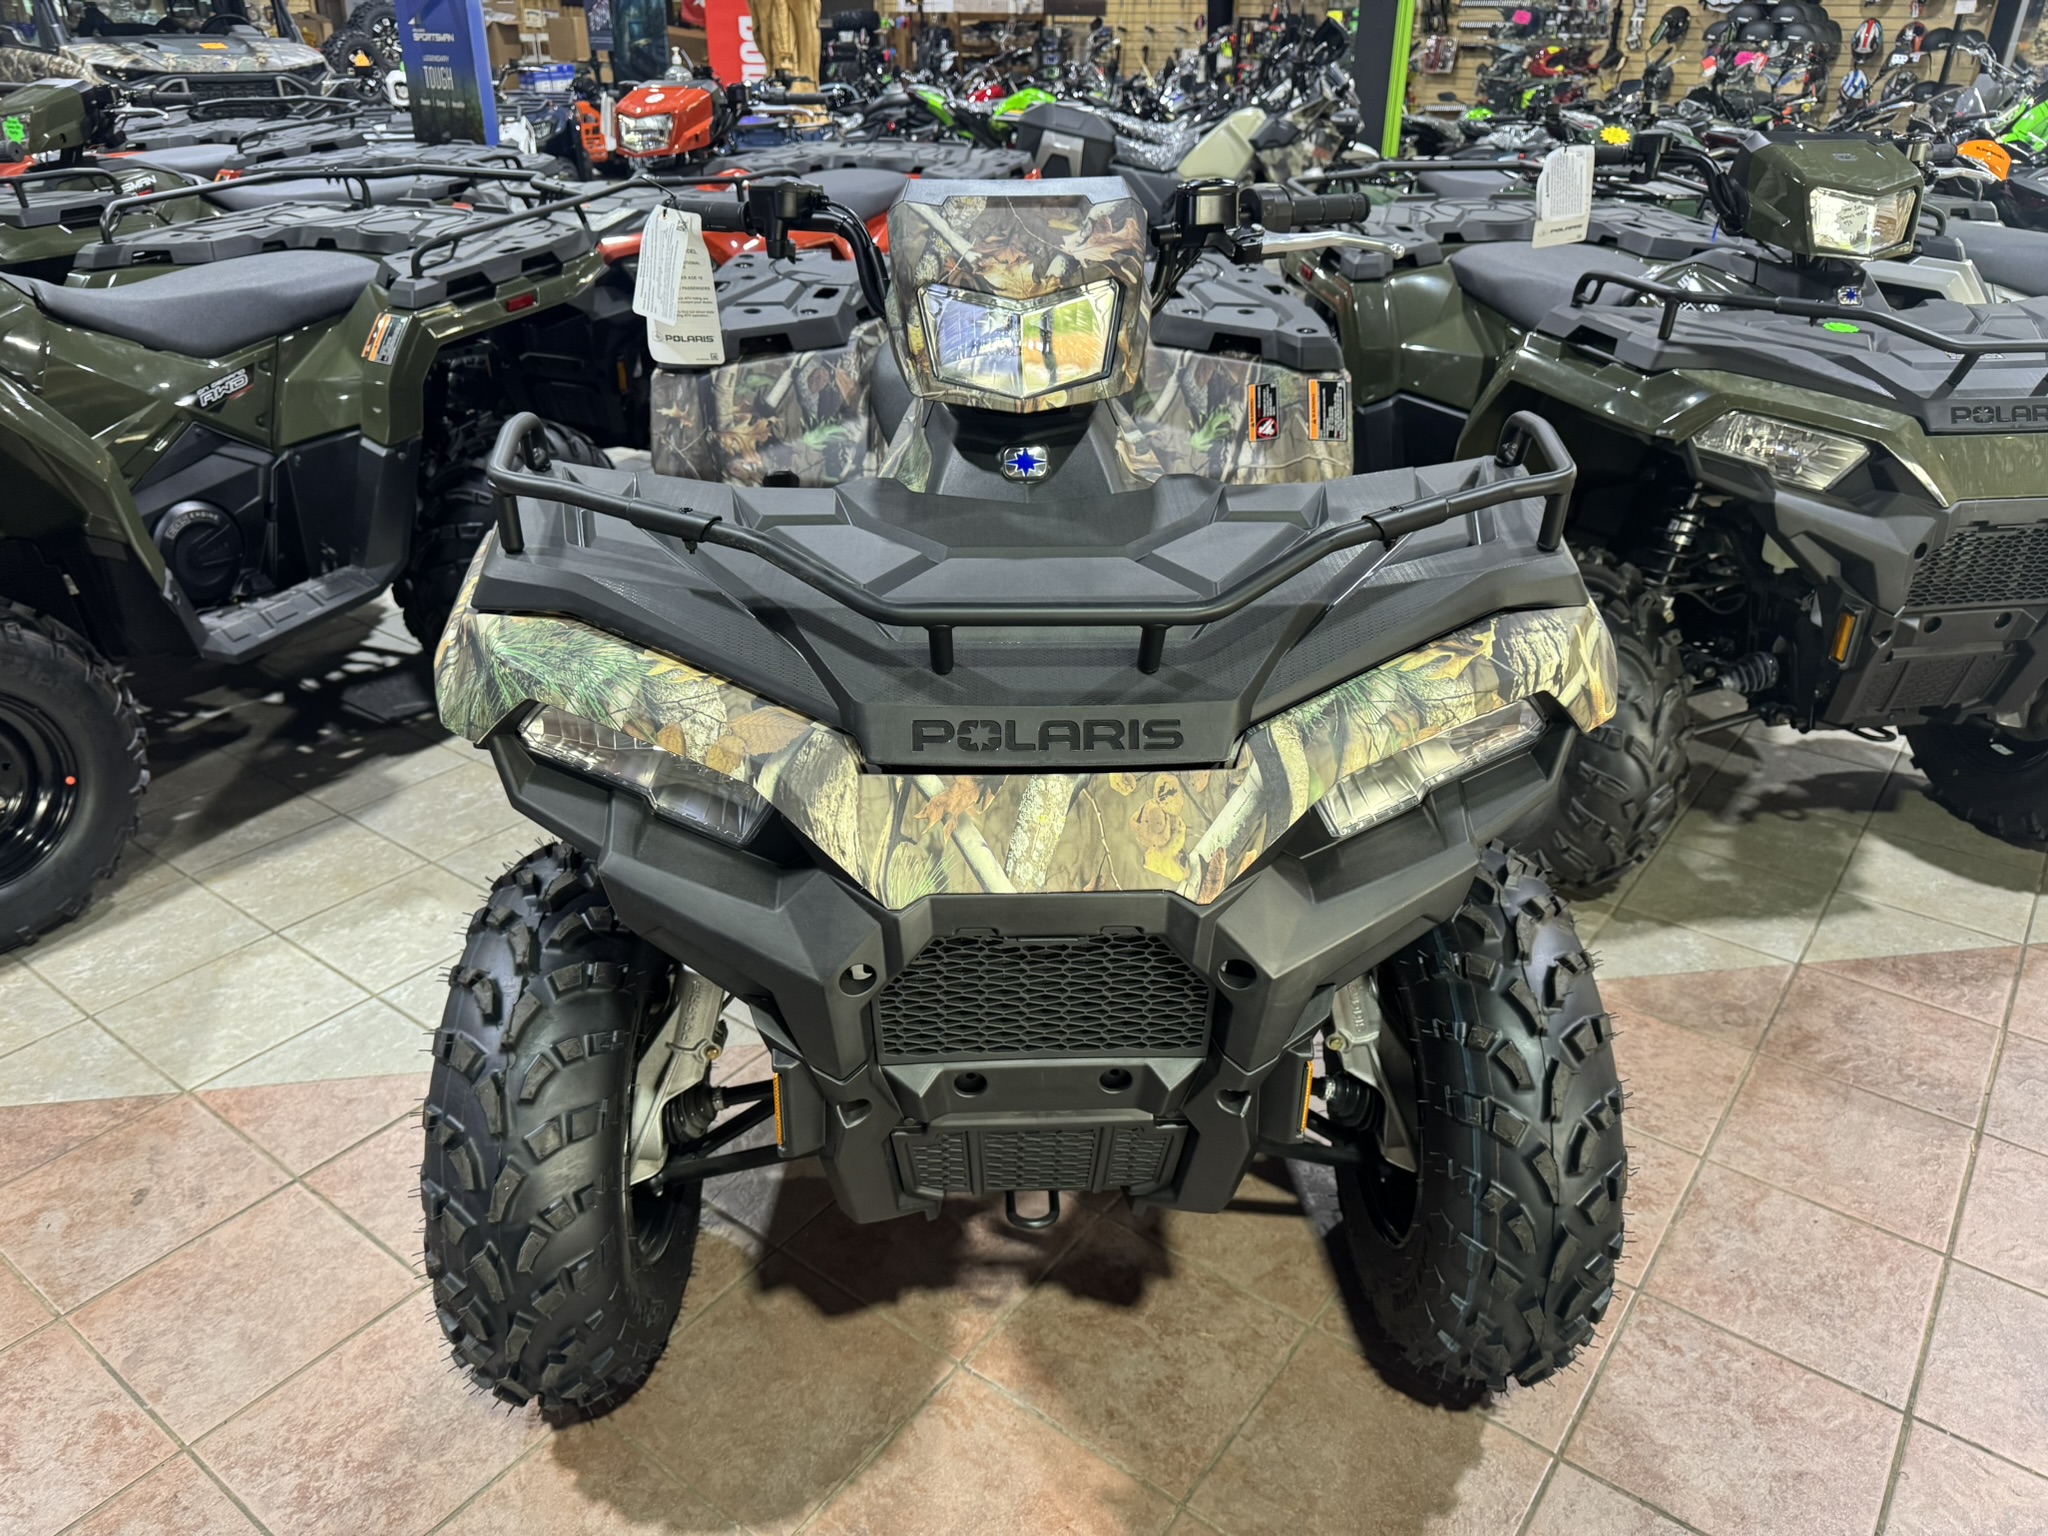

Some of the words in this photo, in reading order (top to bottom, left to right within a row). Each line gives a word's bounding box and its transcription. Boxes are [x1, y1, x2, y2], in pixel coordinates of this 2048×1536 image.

[412, 32, 454, 42] SPORTSMAN
[422, 54, 449, 62] LEGENDARY
[422, 65, 454, 90] TOUGH
[665, 334, 714, 343] POLARIS
[1950, 404, 2048, 424] POLAR
[911, 719, 1184, 752] POLARIS
